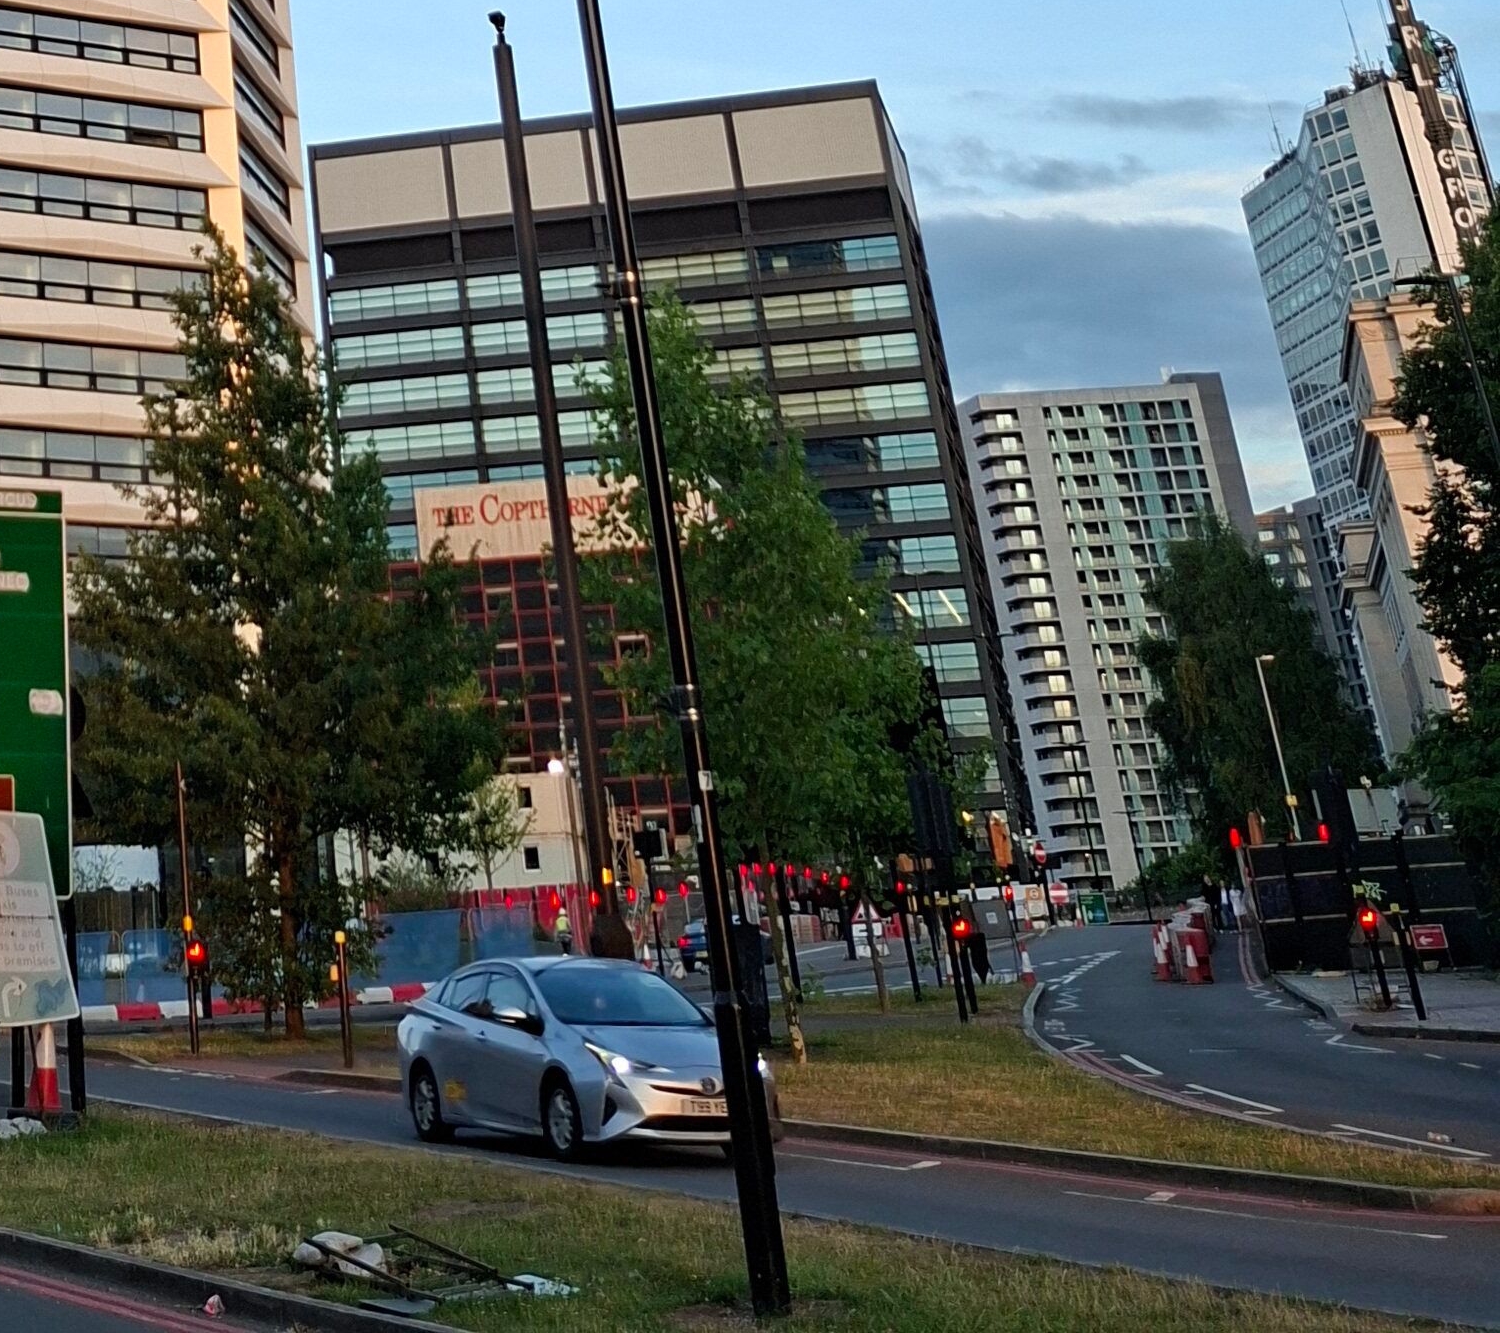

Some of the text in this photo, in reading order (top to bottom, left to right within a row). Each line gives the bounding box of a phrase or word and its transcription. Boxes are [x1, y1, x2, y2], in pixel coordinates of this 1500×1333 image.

[1437, 148, 1482, 249] GRO
[432, 504, 474, 527] THE
[479, 493, 607, 525] COPTHRNE
[5, 884, 39, 897] Buses
